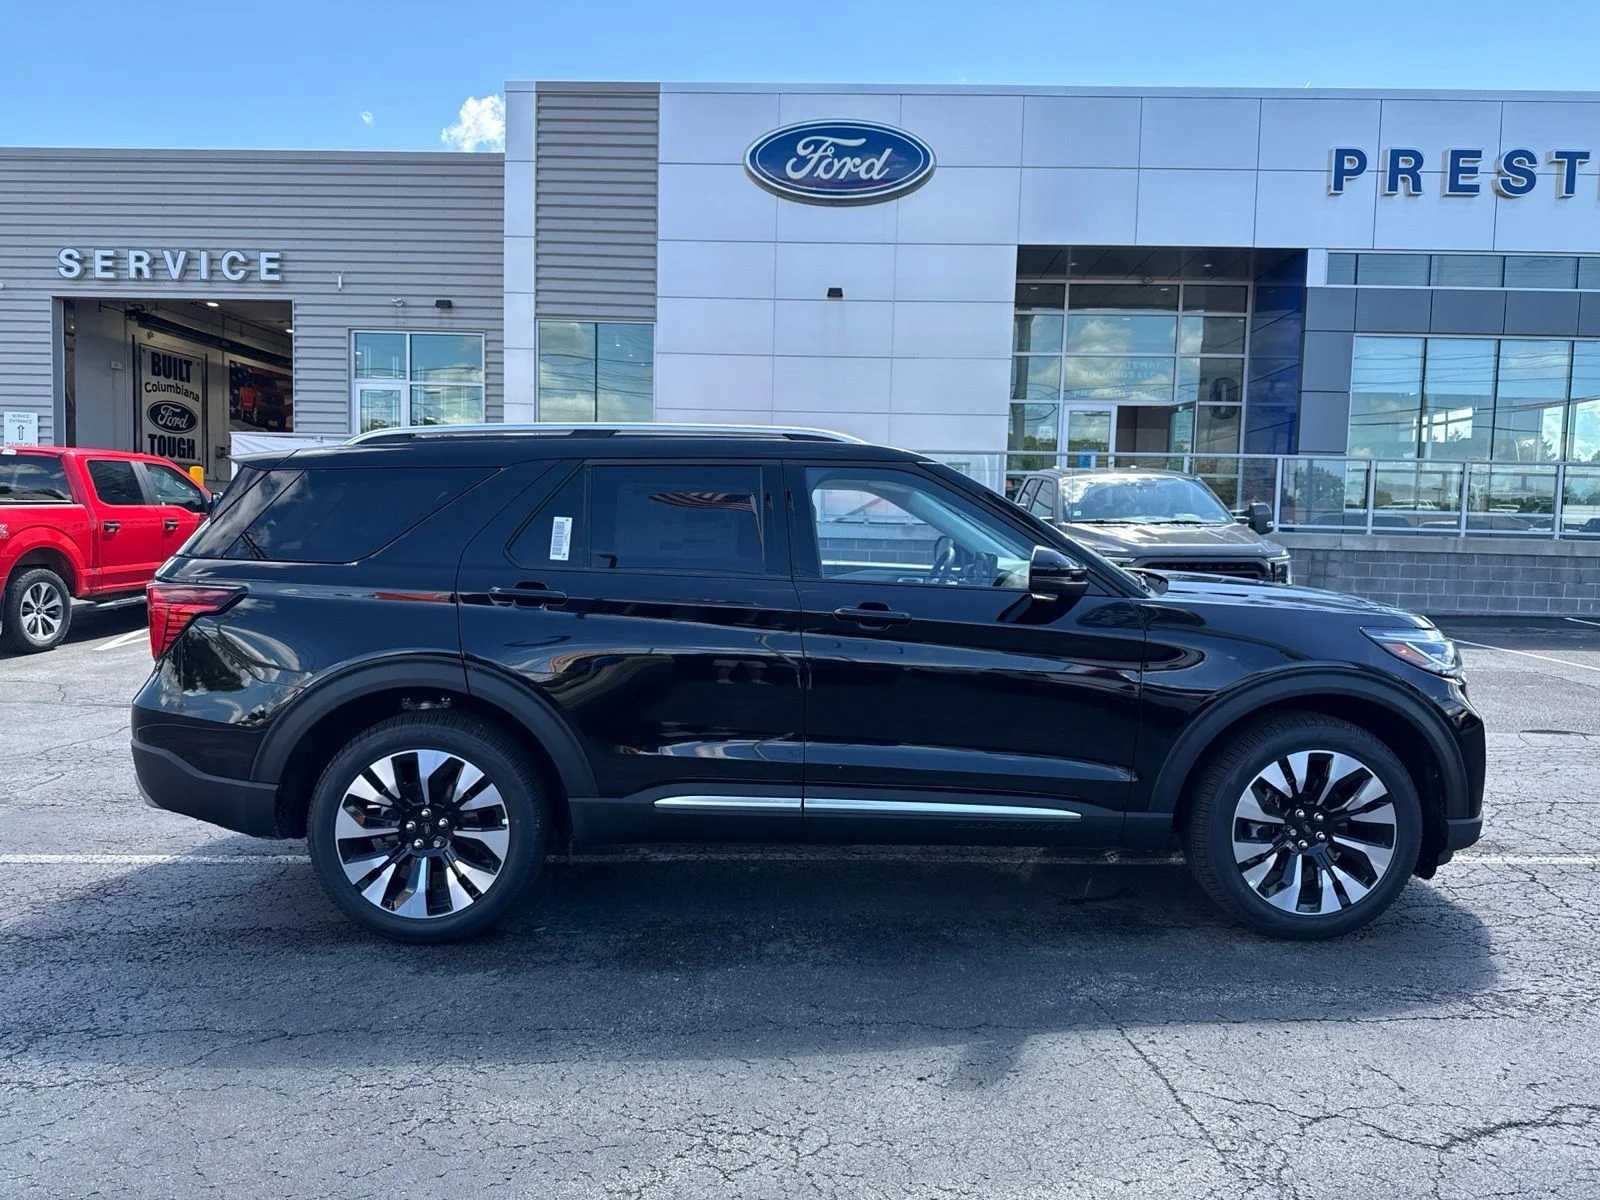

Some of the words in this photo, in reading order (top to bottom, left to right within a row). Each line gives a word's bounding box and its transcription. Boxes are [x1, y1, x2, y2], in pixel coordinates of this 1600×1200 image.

[785, 135, 893, 181] Ford
[1329, 147, 1592, 198] PREST
[58, 247, 282, 282] SERVICE
[151, 351, 193, 383] BUILT
[144, 381, 200, 403] Columbiana
[157, 404, 189, 429] Ford
[148, 434, 196, 460] TOUGH
